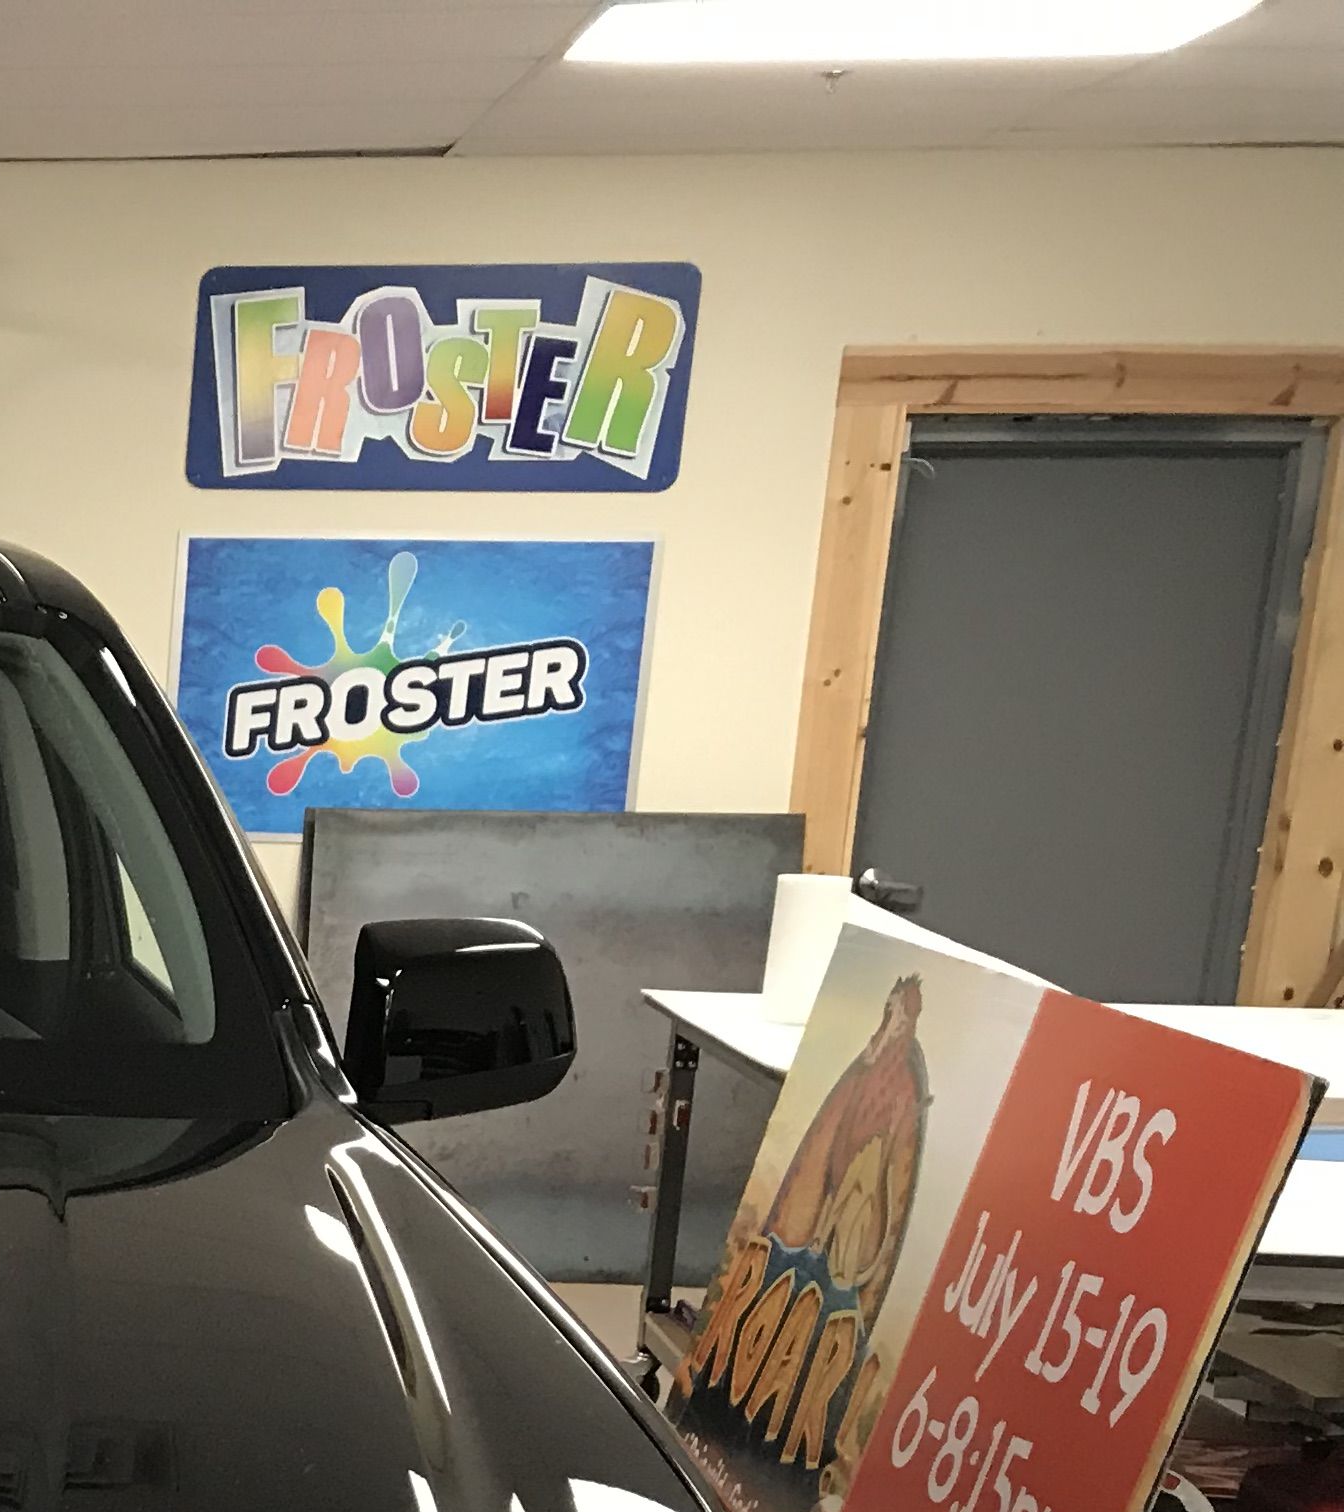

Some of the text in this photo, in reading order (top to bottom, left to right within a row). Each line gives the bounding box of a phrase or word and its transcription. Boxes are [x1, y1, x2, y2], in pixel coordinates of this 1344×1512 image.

[228, 286, 684, 466] FROSTER
[226, 638, 589, 759] FROSTER
[1050, 1078, 1178, 1234] VBS
[944, 1211, 1169, 1427] July 15-19
